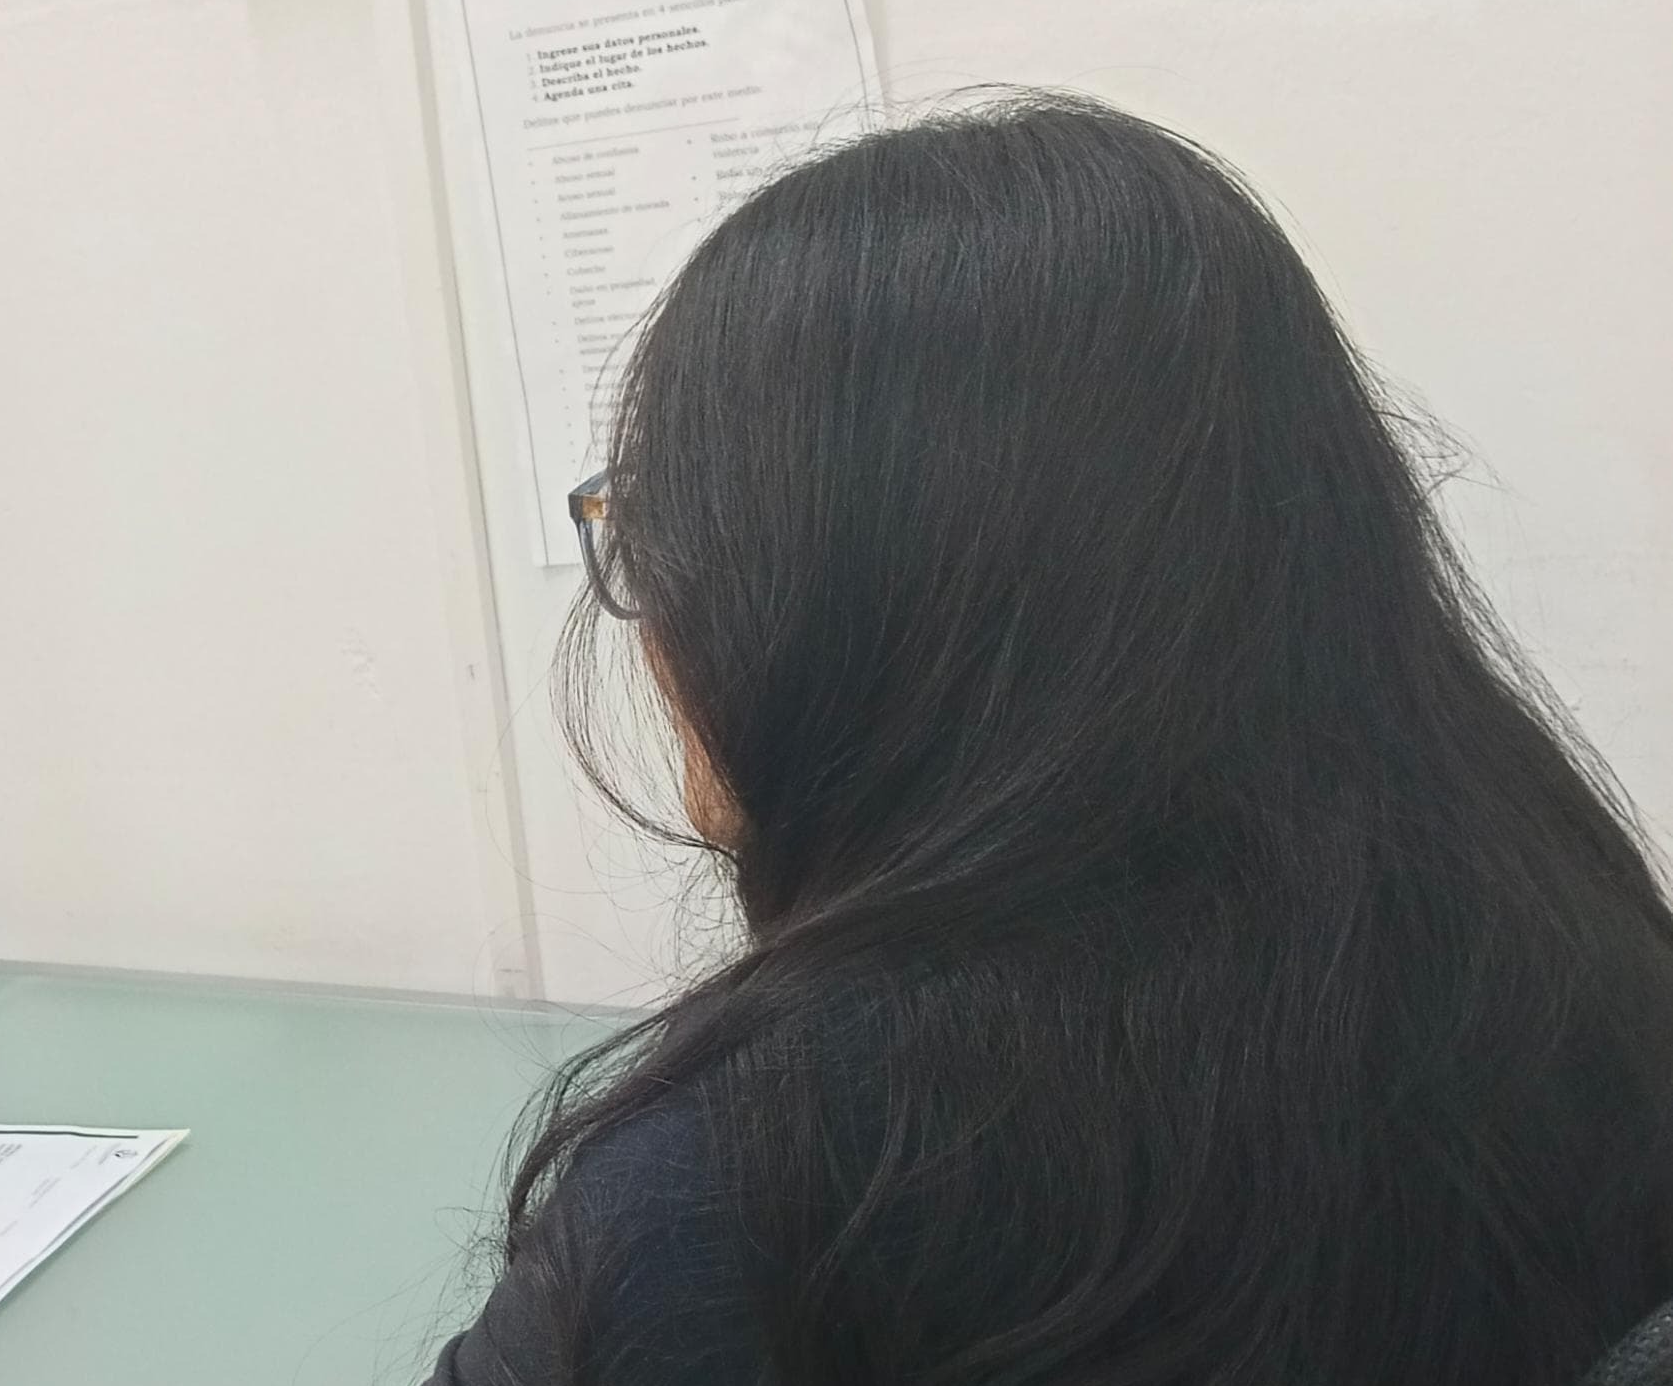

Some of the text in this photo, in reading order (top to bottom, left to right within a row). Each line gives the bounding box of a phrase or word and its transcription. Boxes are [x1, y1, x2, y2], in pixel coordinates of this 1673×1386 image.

[537, 45, 578, 60] Ingrese
[582, 44, 600, 52] sus
[604, 35, 634, 48] datos
[540, 58, 581, 74] Indique
[585, 55, 595, 66] el
[598, 51, 626, 65] lugar
[630, 47, 643, 58] de
[646, 44, 662, 55] los
[542, 71, 588, 87] Describa
[592, 69, 602, 79] el
[543, 86, 583, 102] Agenda
[587, 84, 607, 95] una
